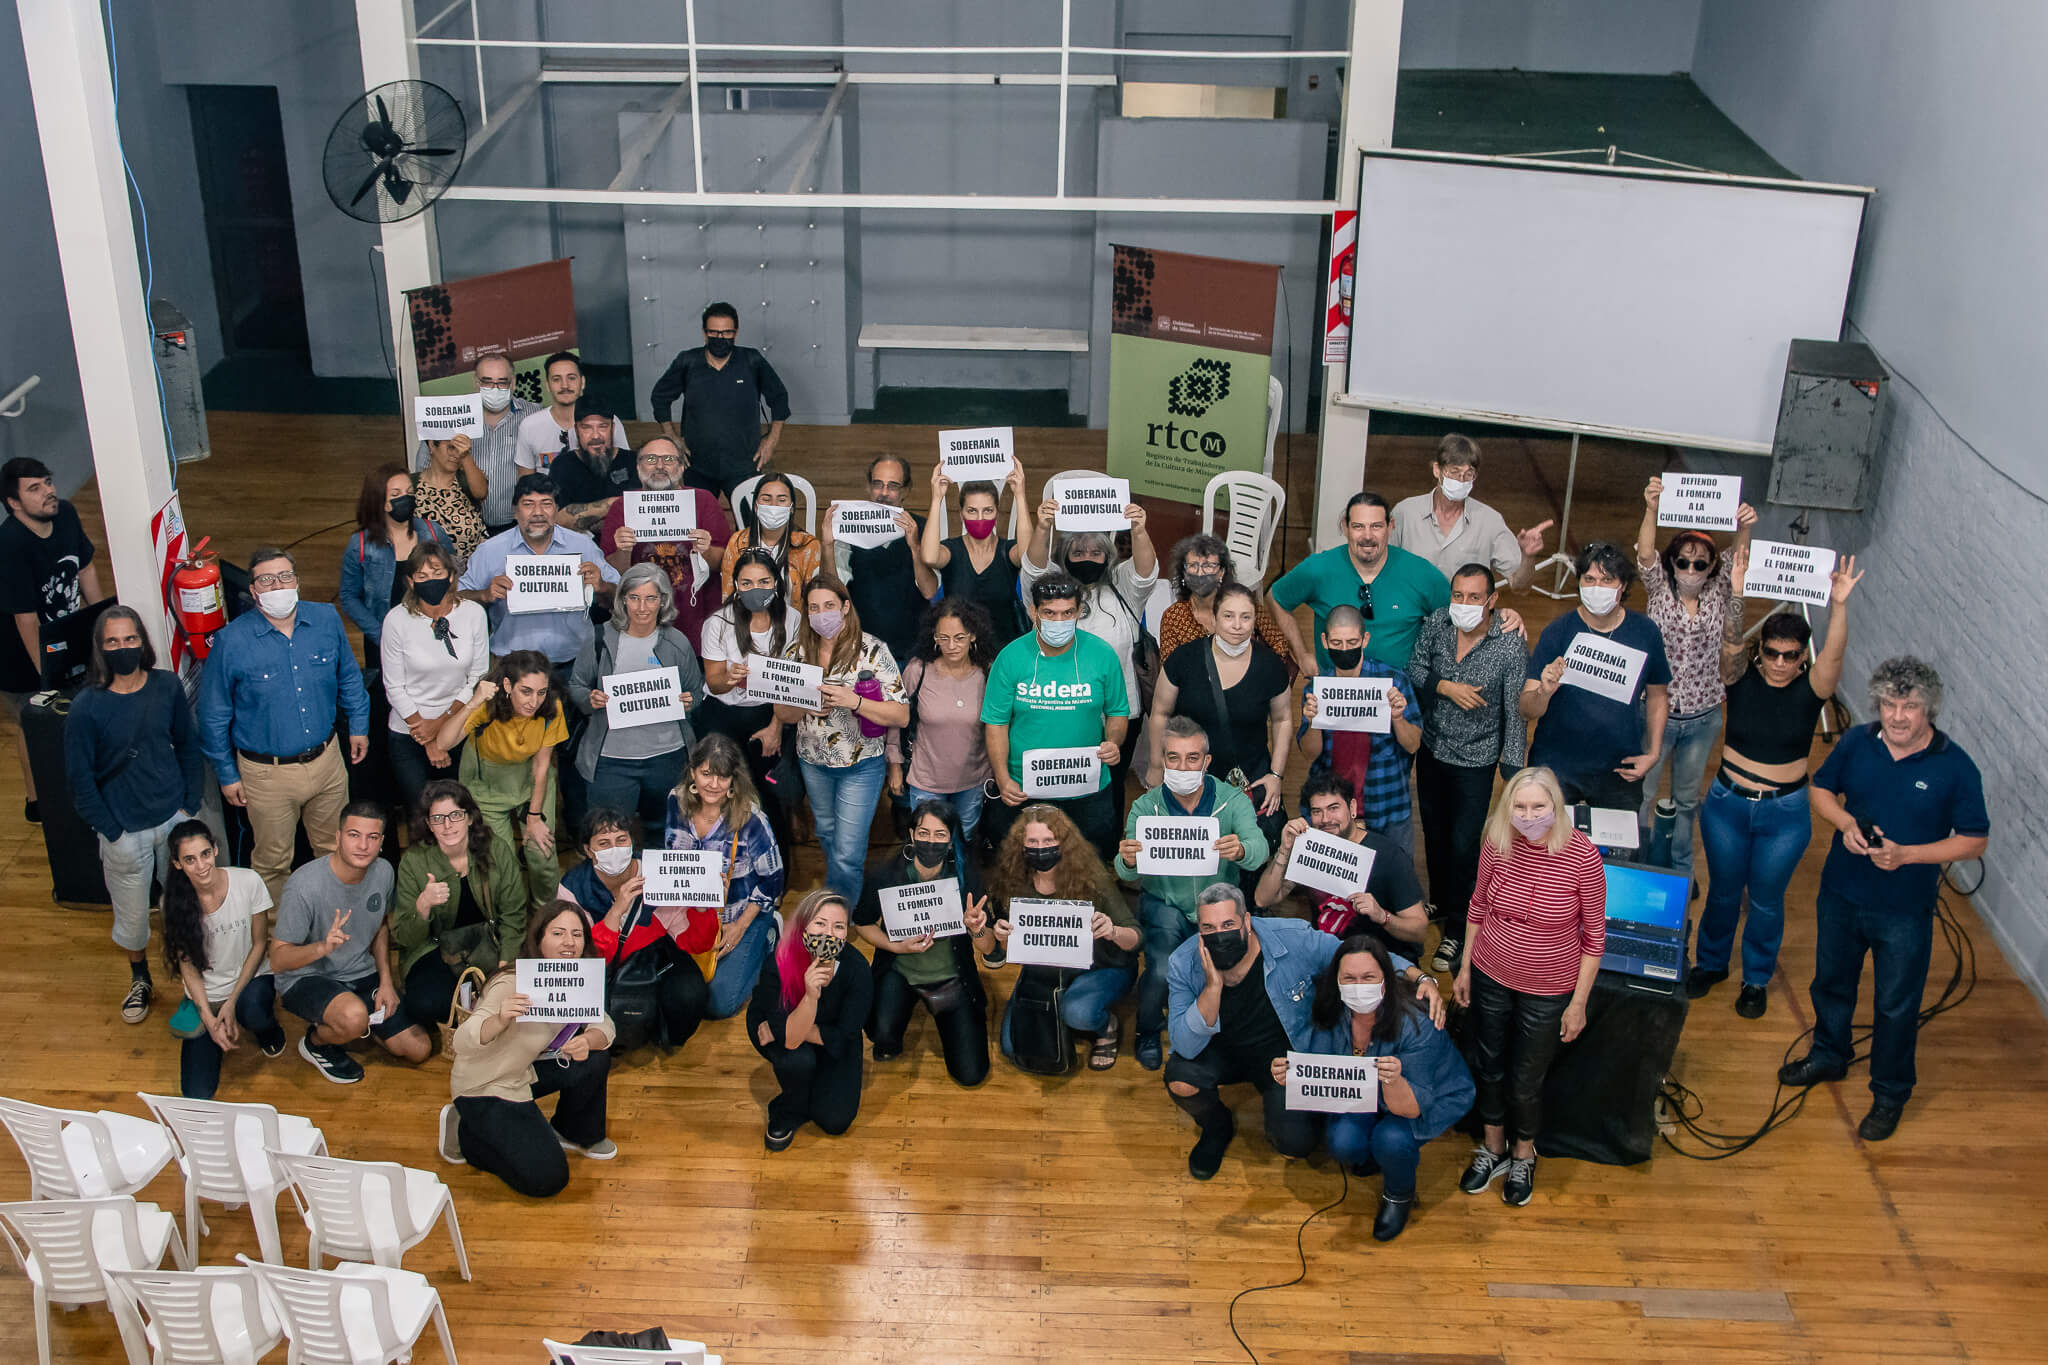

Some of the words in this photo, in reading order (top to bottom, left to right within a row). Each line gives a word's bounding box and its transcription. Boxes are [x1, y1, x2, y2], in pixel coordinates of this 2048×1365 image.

[425, 404, 472, 416] SOBERANÍA
[422, 417, 476, 429] AUDIOVISUAL
[950, 437, 1000, 451] SOBERANÍA
[947, 453, 1006, 466] AUDIOVISUAL
[1680, 476, 1718, 487] DEFIENDO
[641, 493, 675, 502] DEFIENDO
[1065, 487, 1117, 500] SOBERANÍA
[1676, 489, 1684, 498] EL
[1685, 490, 1722, 500] FOMENTO
[638, 506, 646, 514] EL
[647, 505, 680, 514] FOMENTO
[1061, 503, 1122, 515] AUDIOVISUAL
[1688, 502, 1694, 510] A
[1695, 502, 1705, 511] LA
[841, 508, 891, 521] SOBERANÍA
[1660, 512, 1693, 524] CULTURA
[1694, 515, 1733, 526] NACIONAL
[651, 518, 657, 526] A
[658, 518, 666, 526] LA
[659, 528, 690, 537] NACIONA
[839, 524, 896, 534] AUDIOVISUAL
[1771, 545, 1811, 560] DEFIENDO
[514, 563, 572, 576] SOBERANÍA
[1764, 558, 1774, 569] EL
[1775, 560, 1814, 574] FOMENTO
[1777, 573, 1783, 582] A
[1784, 574, 1795, 583] LA
[519, 582, 569, 593] CULTURAL
[1745, 582, 1782, 594] CULTURA
[1784, 585, 1826, 600] NACIONAL
[1574, 644, 1627, 669] SOBERANÍA
[766, 660, 801, 674] DEFIENDO
[762, 671, 770, 680] EL
[771, 673, 805, 686] FOMENTO
[612, 676, 672, 697] SOBERANÍA
[774, 684, 780, 692] A
[1016, 680, 1092, 698] sadem
[749, 690, 780, 702] CULTURA
[782, 695, 818, 708] NACIONAL
[1321, 687, 1382, 701] SOBERANÍA
[620, 695, 672, 714] CULTURAL
[1326, 705, 1378, 718] CULTURAL
[1031, 756, 1091, 771] SOBERANÍA
[1036, 773, 1088, 787] CULTURAL
[1144, 826, 1209, 841] SOBERANÍA
[662, 853, 700, 862] DEFIENDO
[1150, 846, 1206, 860] CULTURAL
[1305, 839, 1358, 867] SOBERANÍA
[659, 866, 668, 874] EL
[669, 866, 706, 875] FOMENTO
[1296, 854, 1358, 884] AUDIOVISUAL
[673, 879, 679, 888] A
[680, 879, 690, 888] LA
[645, 892, 680, 901] CULTURA
[682, 892, 720, 902] NACIONAL
[899, 884, 936, 898] DEFIENDO
[897, 902, 907, 912] EL
[907, 896, 944, 910] FOMENTO
[914, 913, 919, 922] A
[920, 912, 930, 921] LA
[1018, 914, 1083, 929] SOBERANÍA
[889, 926, 923, 937] CULTURA
[1023, 933, 1080, 948] CULTURAL
[538, 962, 579, 972] DEFIENDO
[534, 978, 543, 988] EL
[544, 977, 584, 988] FOMENTO
[548, 993, 554, 1003] A
[555, 993, 567, 1003] LA
[556, 1007, 601, 1017] NACIONAL
[1296, 1064, 1366, 1081] SOBERANÍA
[1301, 1084, 1363, 1100] CULTURAL
